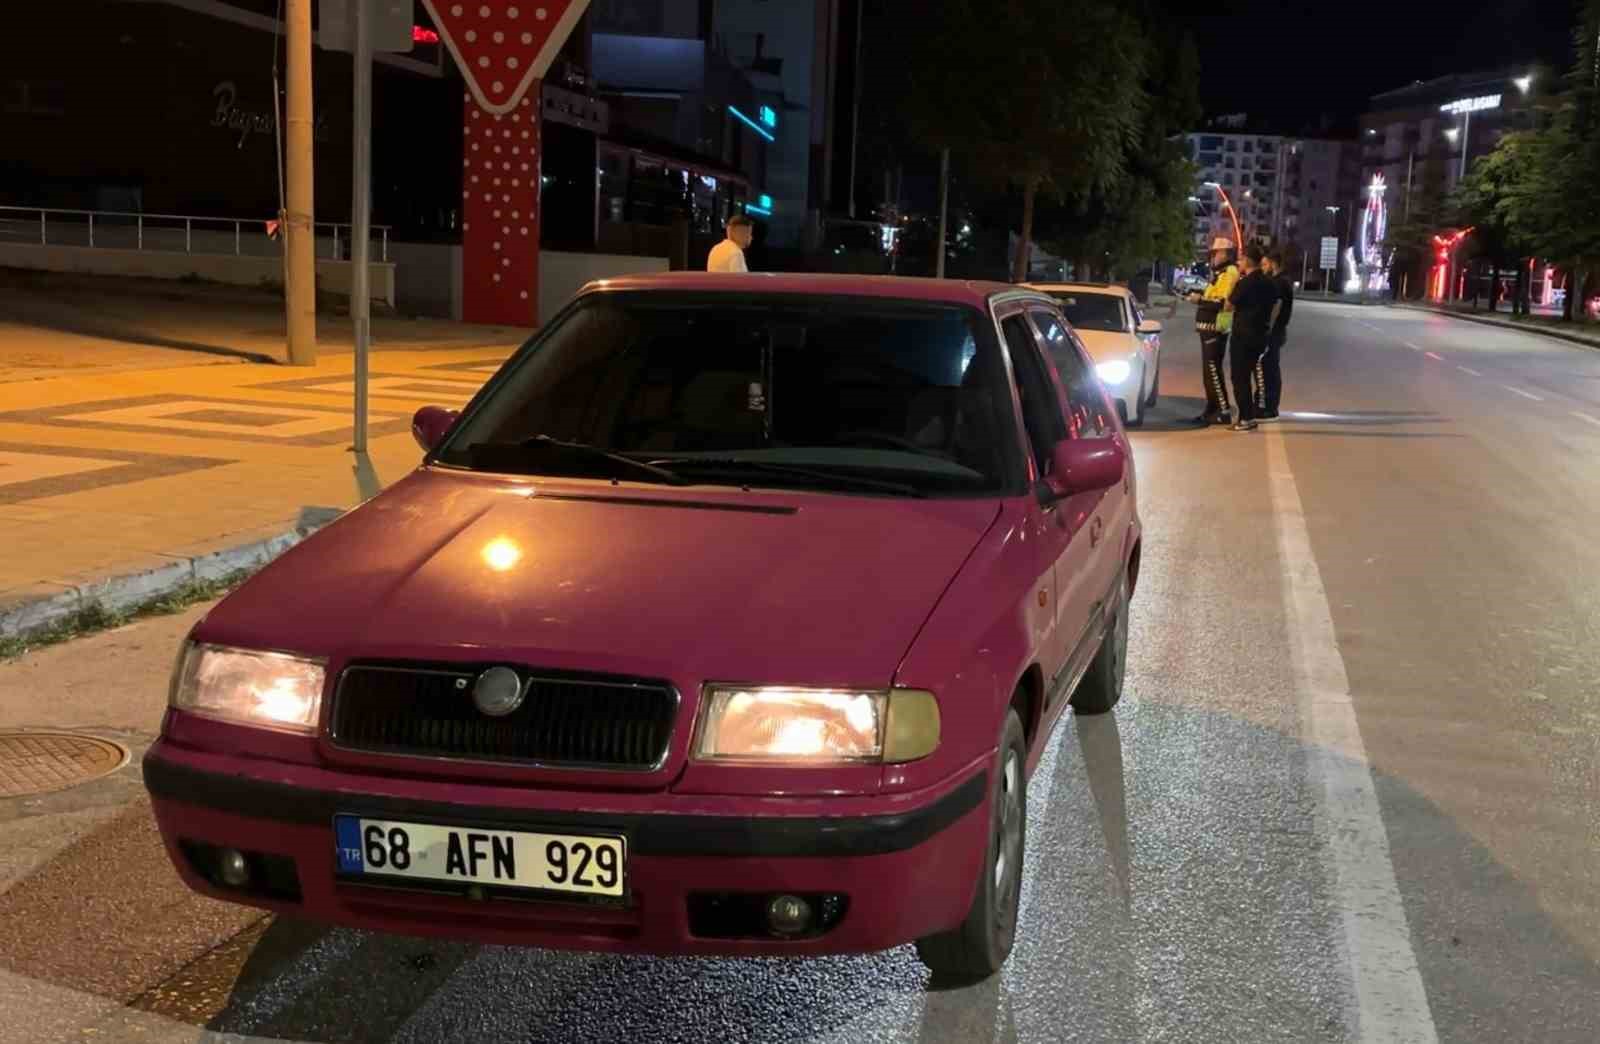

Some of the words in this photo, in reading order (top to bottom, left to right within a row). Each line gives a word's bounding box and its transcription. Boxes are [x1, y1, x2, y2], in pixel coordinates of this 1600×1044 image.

[343, 847, 361, 861] TR
[364, 826, 411, 870] 68
[446, 832, 516, 880] AFN
[546, 841, 618, 889] 929
